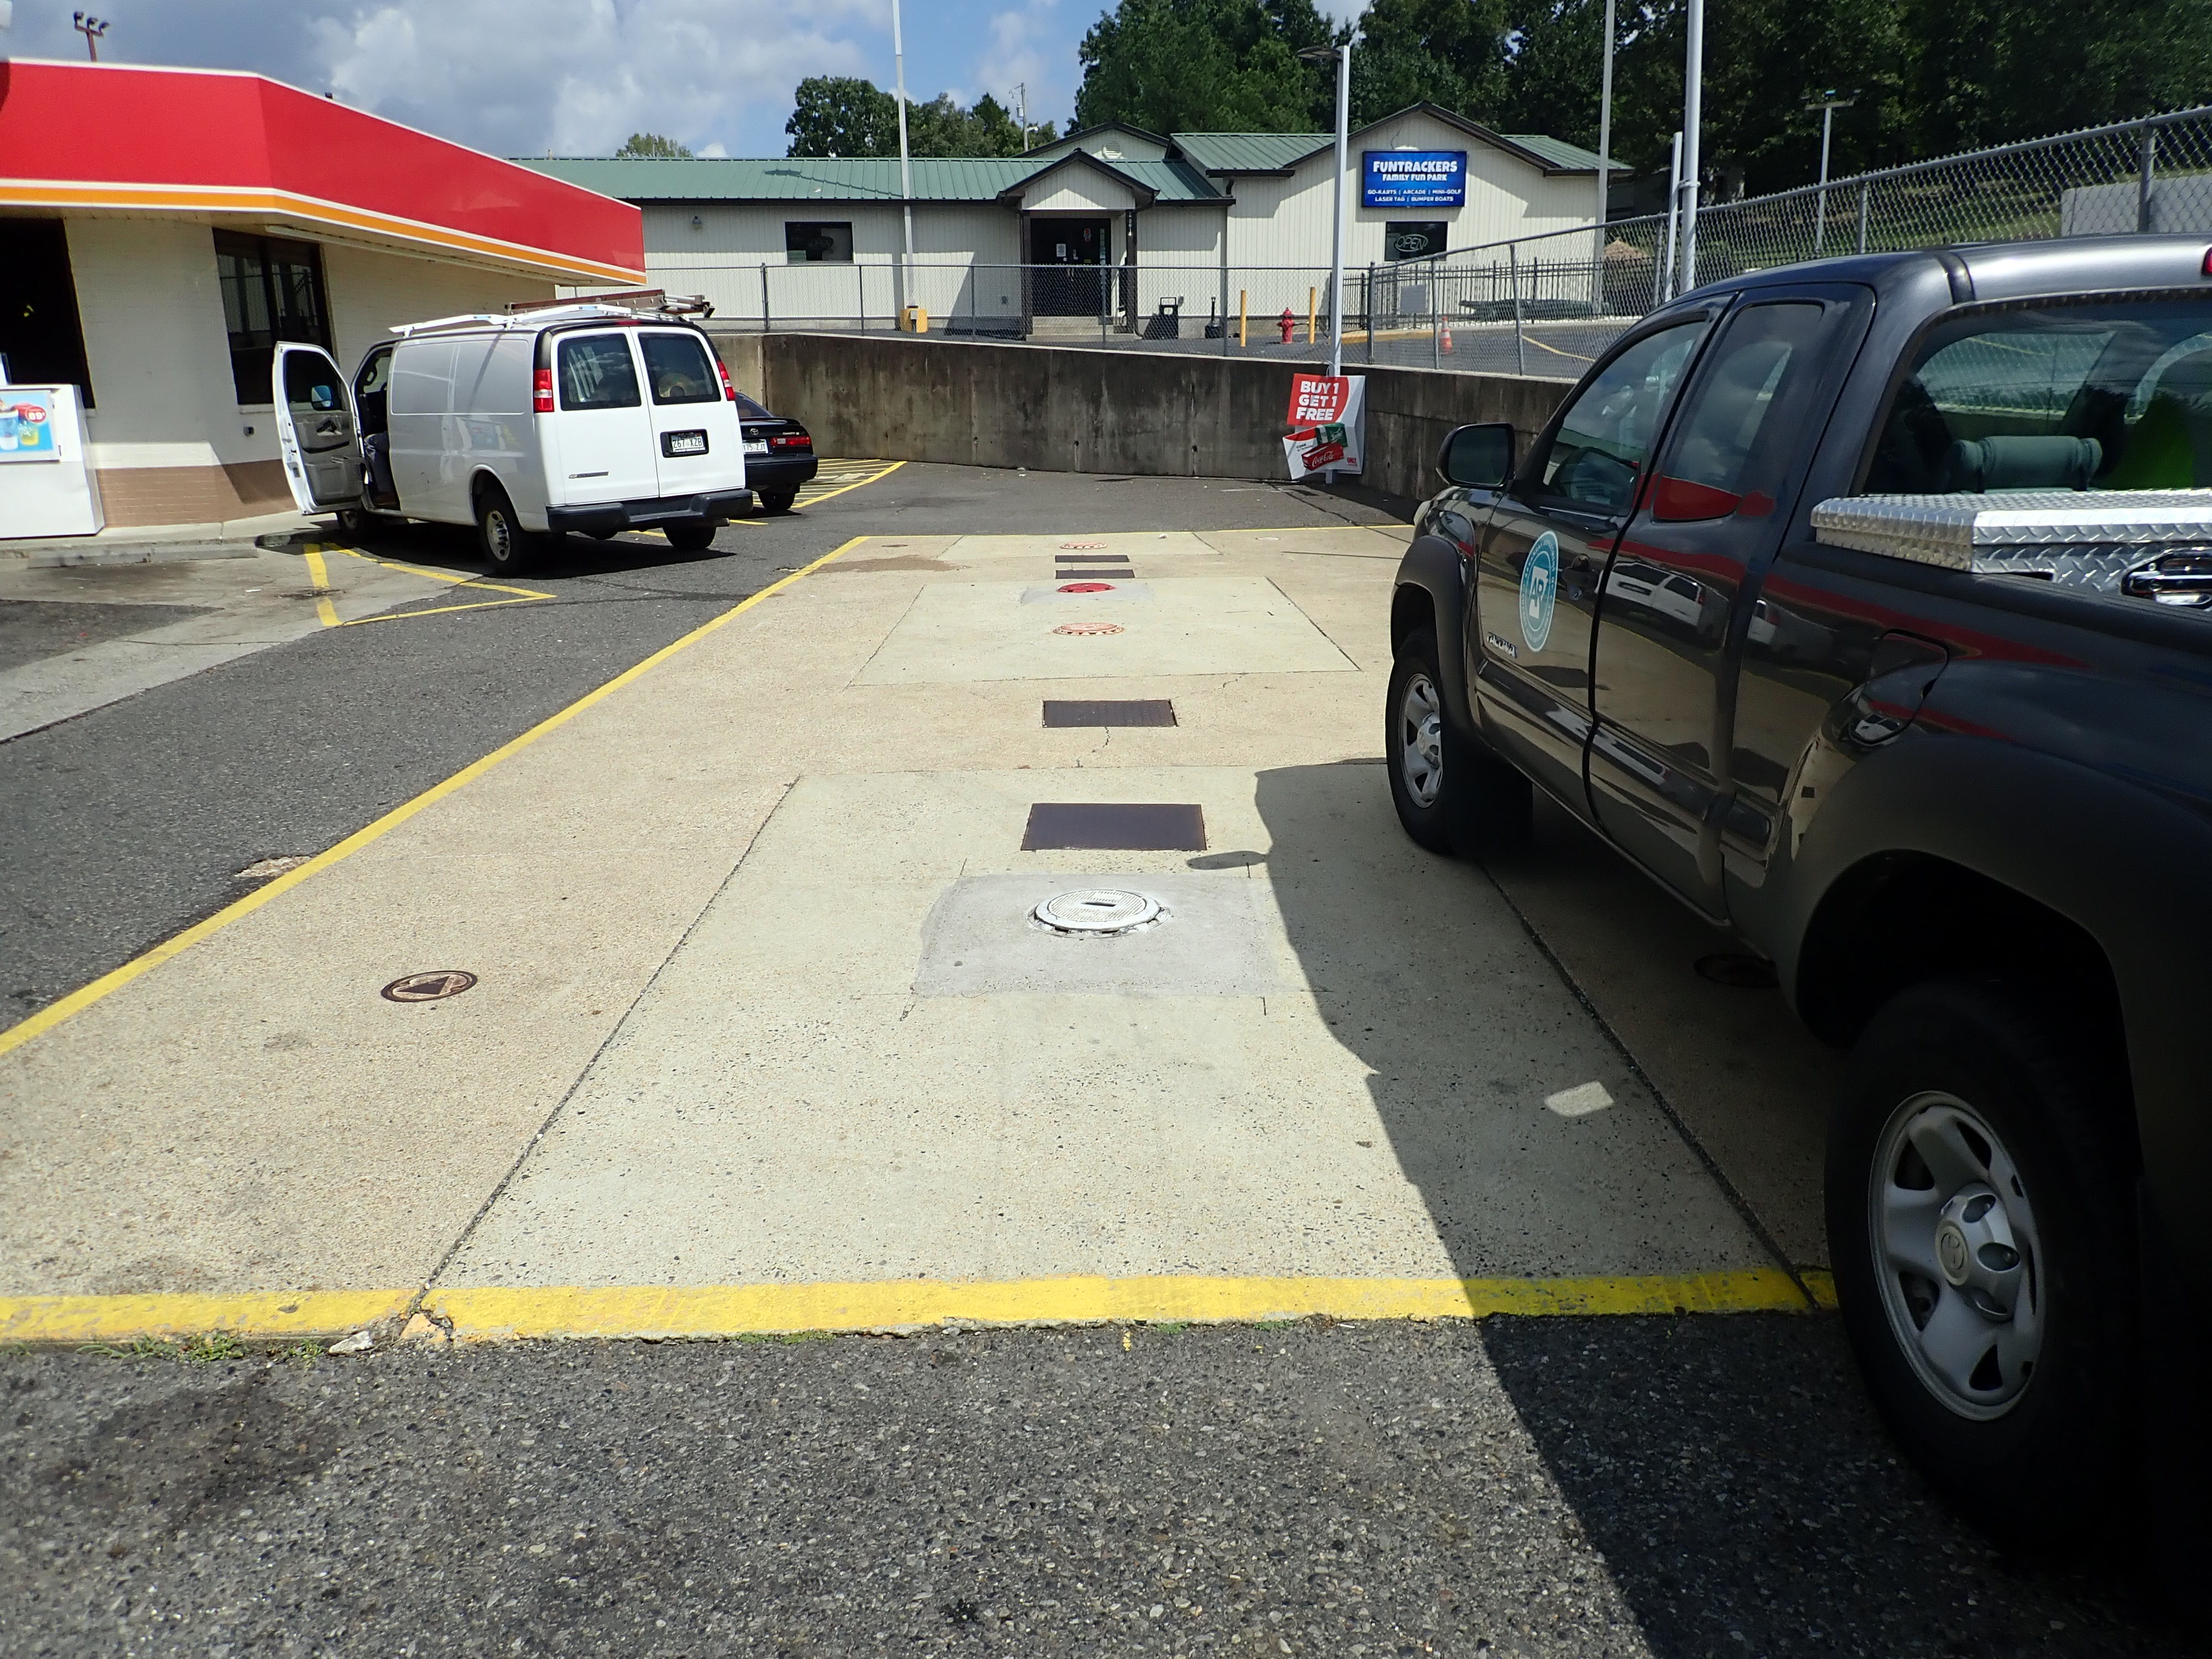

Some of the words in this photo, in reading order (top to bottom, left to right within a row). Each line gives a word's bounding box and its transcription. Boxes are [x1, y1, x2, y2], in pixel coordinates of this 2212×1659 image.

[1373, 161, 1458, 173] FUNTRACKERS
[1396, 236, 1426, 250] OPEN
[1301, 380, 1331, 394] BUY
[1333, 382, 1339, 394] 1
[1298, 394, 1328, 407] GET
[1332, 395, 1338, 407] 1
[1296, 407, 1335, 421] FREE
[672, 439, 685, 448] 267
[689, 437, 702, 447] XZB
[1486, 634, 1516, 658] TACOMA
